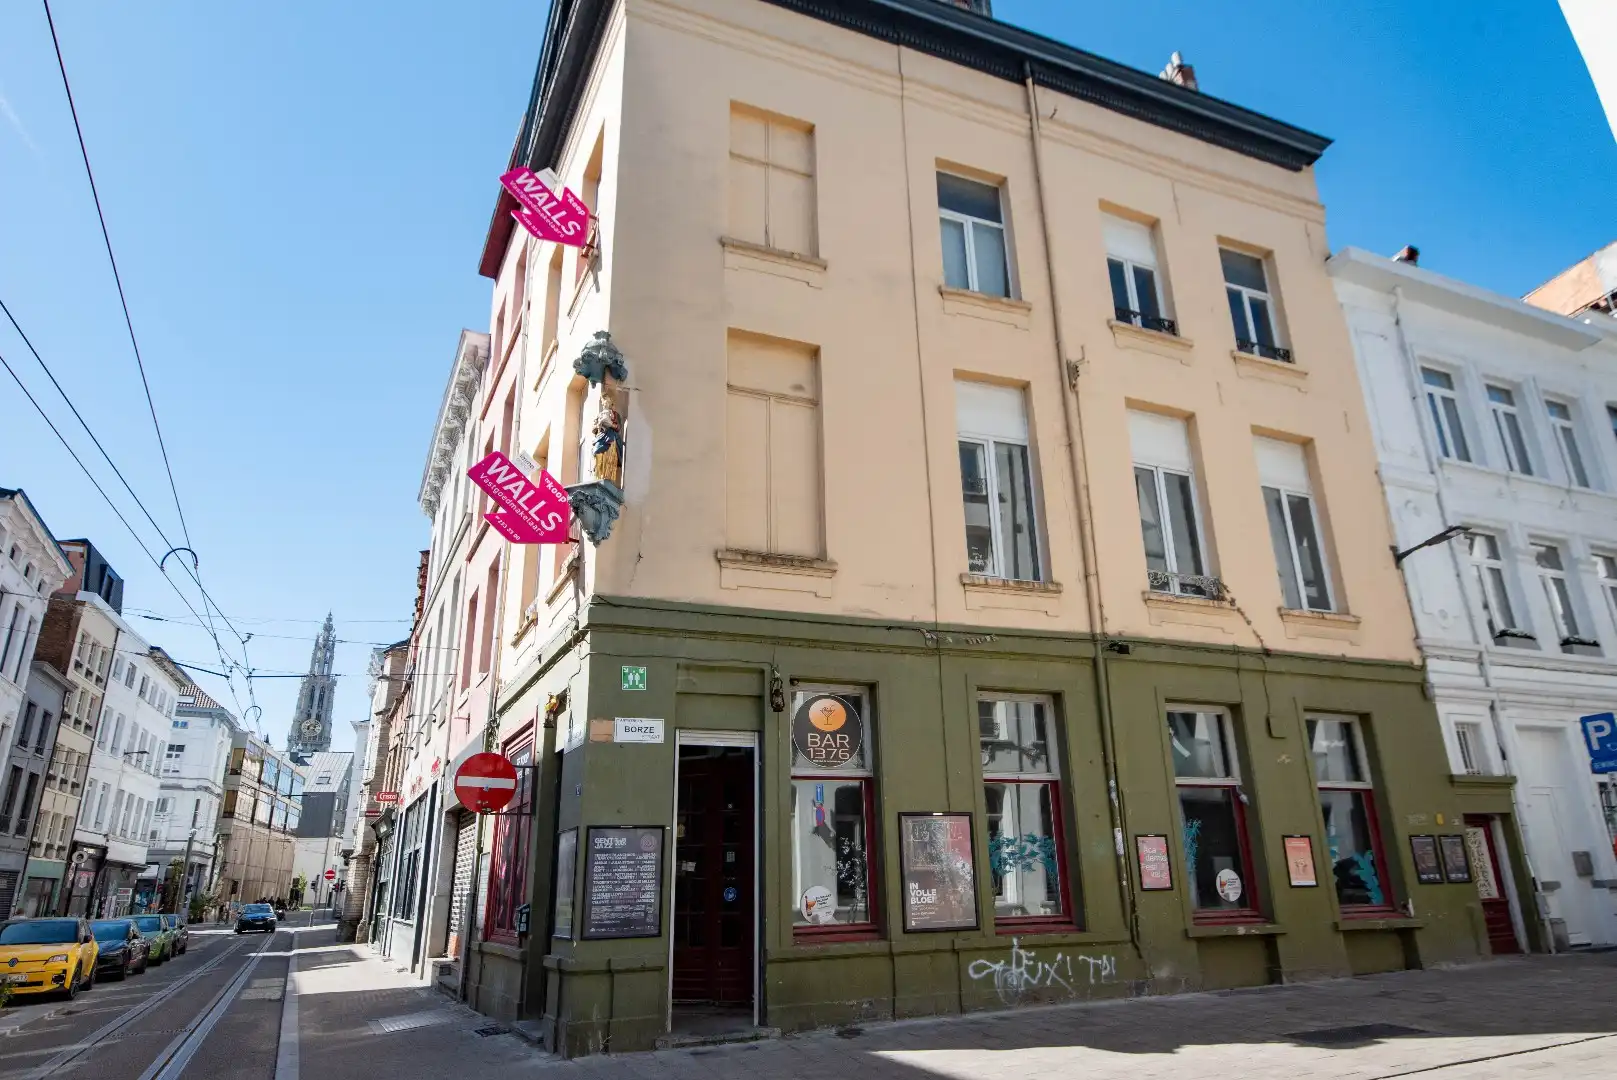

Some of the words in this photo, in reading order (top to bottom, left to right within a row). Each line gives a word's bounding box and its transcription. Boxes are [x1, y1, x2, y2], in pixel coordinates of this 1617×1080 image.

[515, 170, 581, 237] WALLS
[567, 195, 586, 216] koop
[486, 457, 563, 532] WALLS
[547, 482, 567, 503] koop
[479, 472, 545, 537] Vastgoedmakelaars
[624, 725, 655, 734] BORZE
[1586, 720, 1612, 751] P
[807, 733, 850, 748] BAR
[807, 748, 850, 760] 1376
[909, 882, 919, 890] IN
[910, 889, 937, 897] VOLLE
[910, 896, 935, 904] BLOEI
